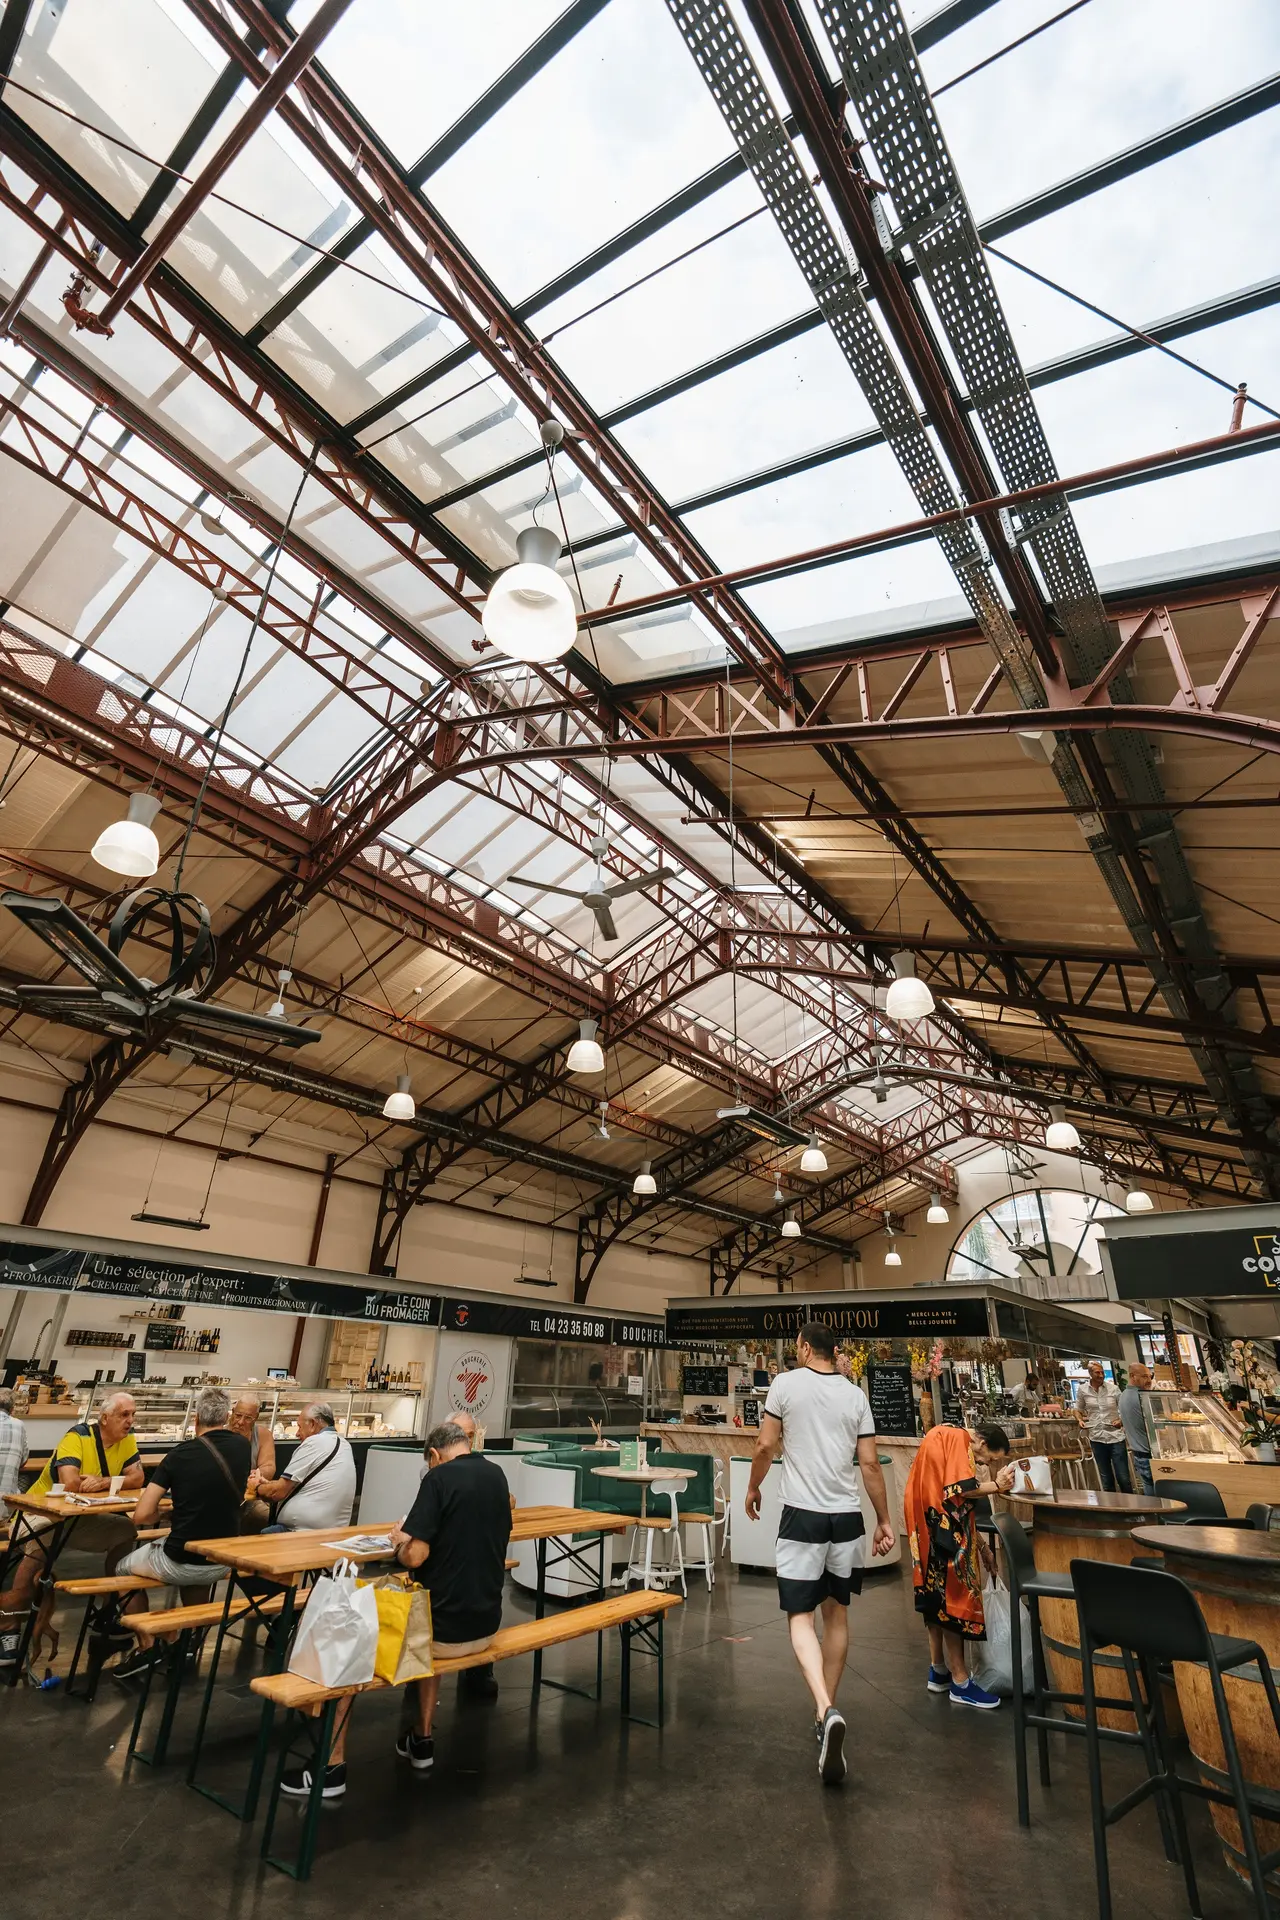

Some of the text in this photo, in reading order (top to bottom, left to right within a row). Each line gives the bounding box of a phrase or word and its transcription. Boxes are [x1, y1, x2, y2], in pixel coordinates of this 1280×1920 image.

[94, 1260, 122, 1276] Une
[127, 1265, 186, 1283] sélection
[194, 1290, 214, 1300] FINE
[225, 1293, 263, 1305] PRODUITS
[397, 1295, 431, 1310] LE COIN
[365, 1300, 430, 1322] DU FROMAGER
[530, 1317, 605, 1338] TEL 04 23 35 50 88
[622, 1326, 673, 1344] BOUCHER
[461, 1356, 487, 1368] BOUCHERIE
